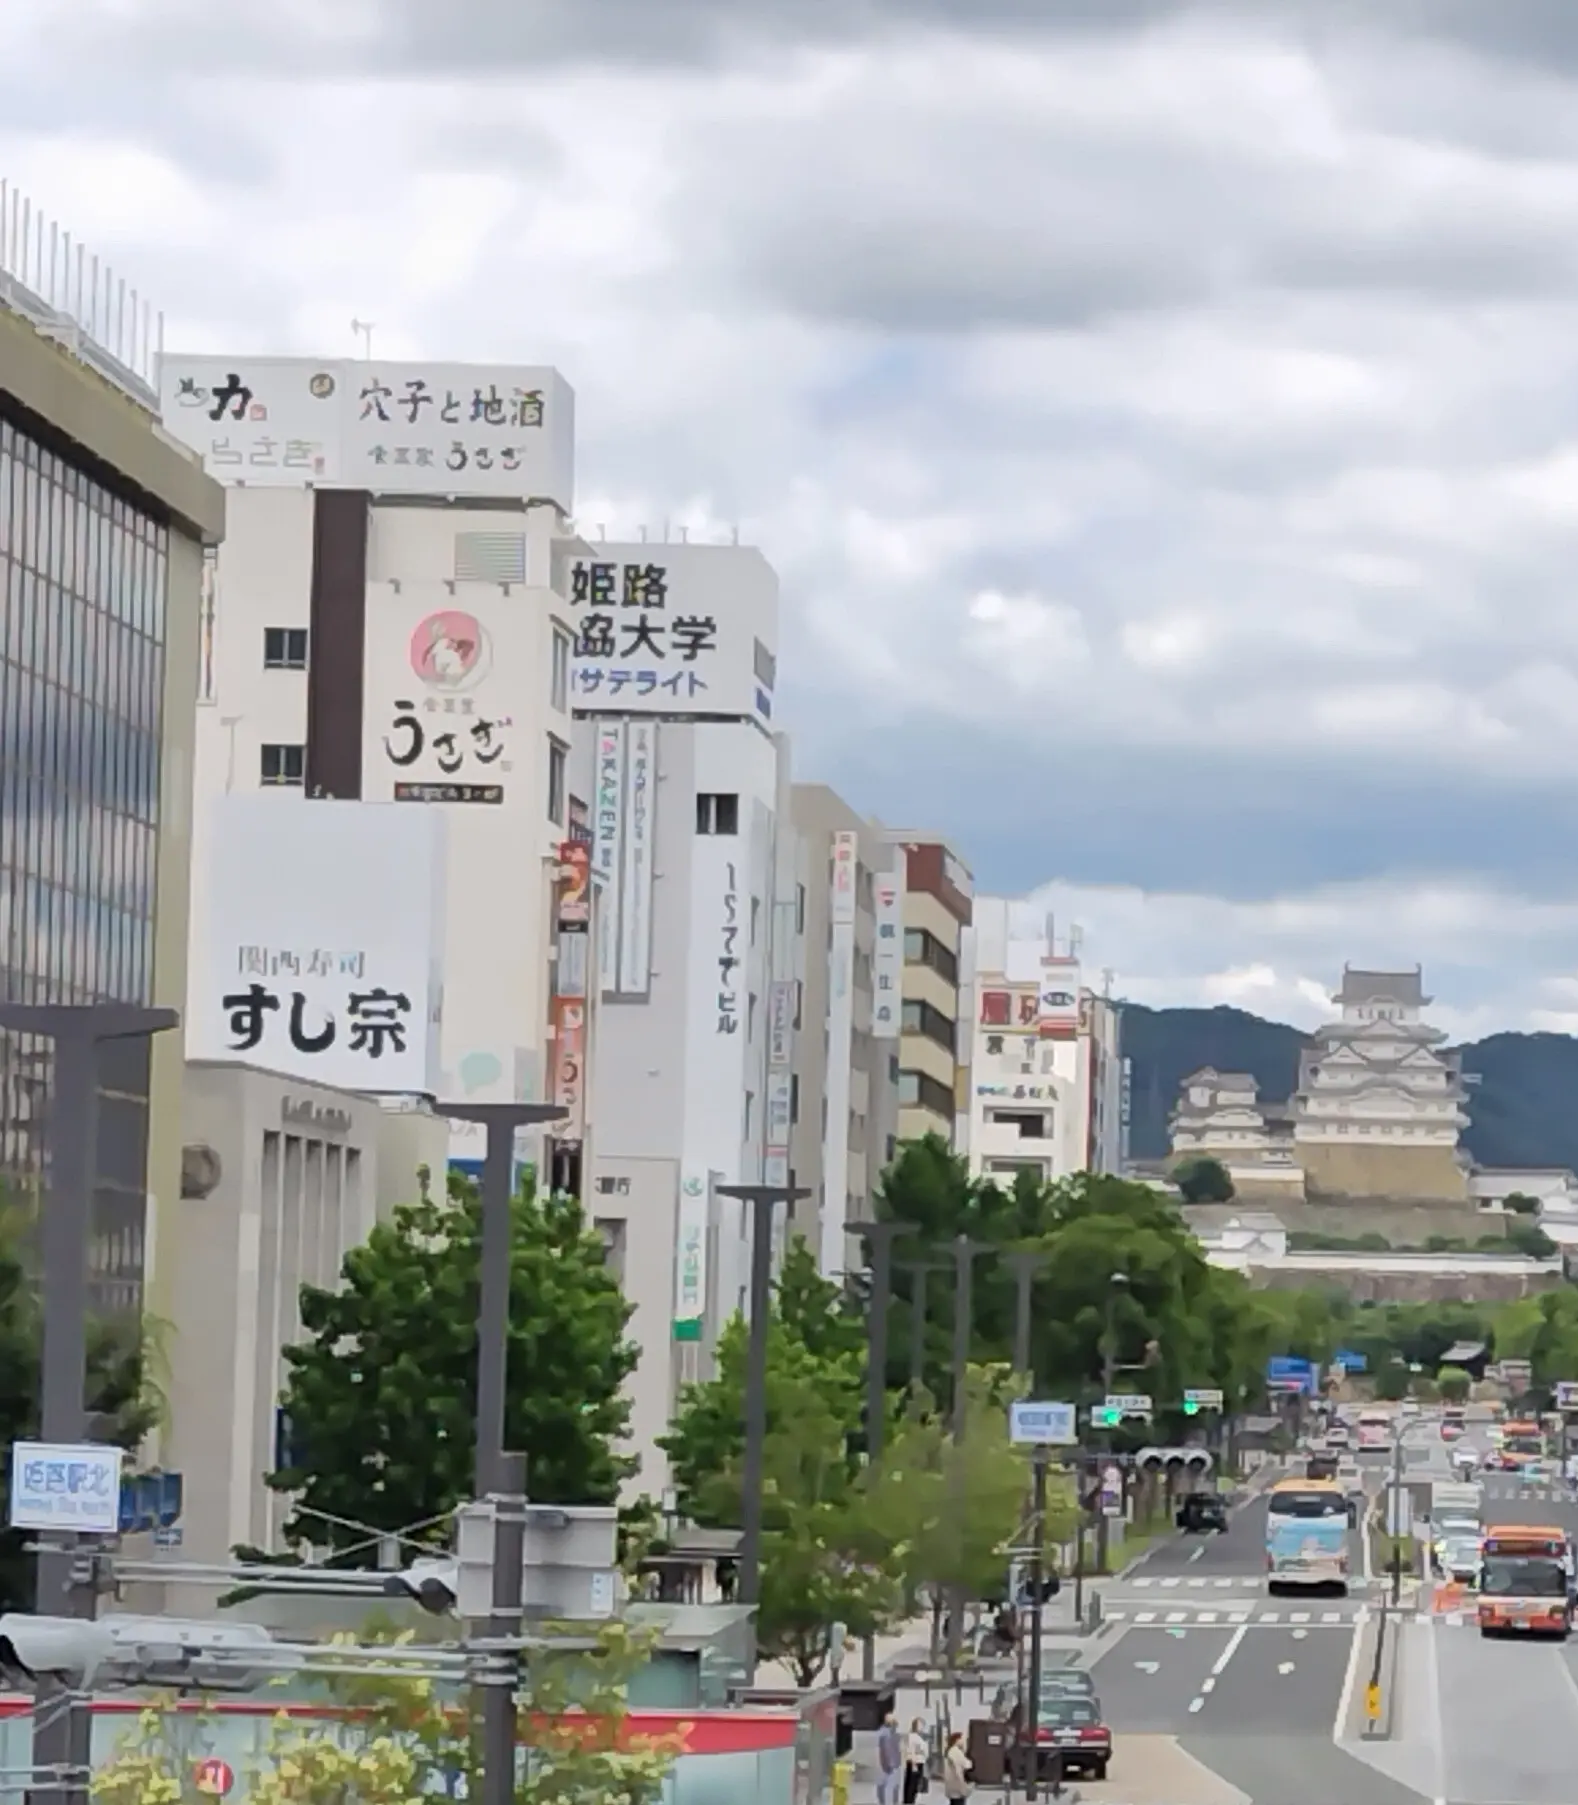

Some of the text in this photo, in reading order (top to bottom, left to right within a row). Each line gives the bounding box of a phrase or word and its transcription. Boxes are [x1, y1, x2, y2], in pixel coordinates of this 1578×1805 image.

[359, 376, 546, 428] 穴子と地酒
[570, 561, 668, 609] 姫路
[571, 668, 708, 697] サテライト
[382, 700, 513, 774] うさぎ
[238, 945, 366, 978] 関西寿司
[222, 983, 412, 1059] すし宗
